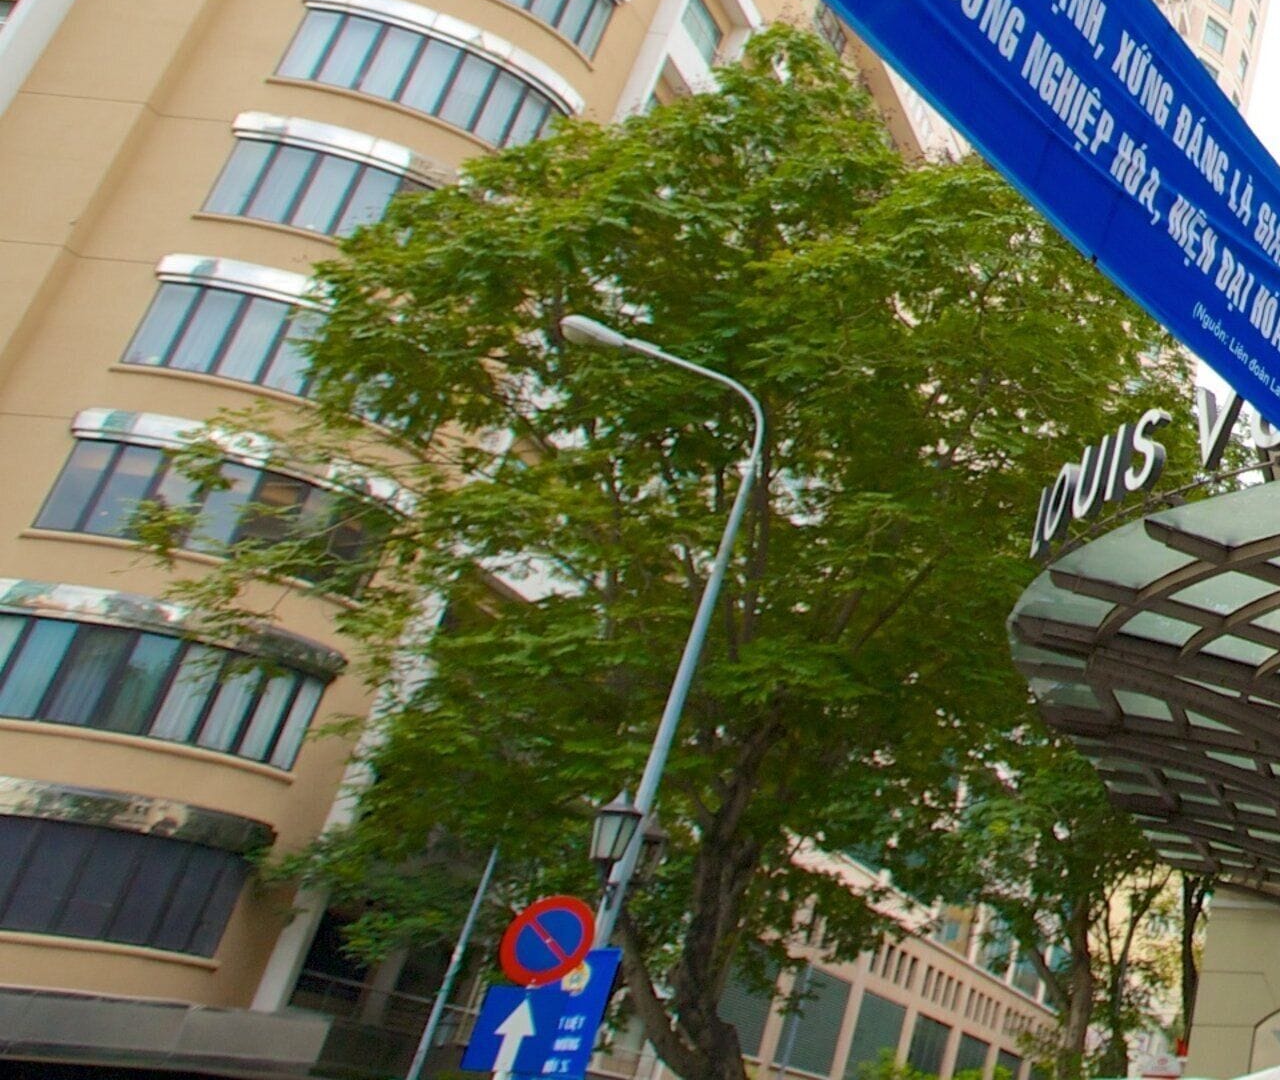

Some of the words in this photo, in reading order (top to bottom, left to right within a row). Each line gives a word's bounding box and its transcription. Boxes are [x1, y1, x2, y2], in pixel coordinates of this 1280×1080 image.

[1021, 31, 1114, 155] NGHIỆP
[1168, 193, 1218, 275] HIỆN
[1214, 246, 1255, 314] ĐẠI
[1111, 29, 1174, 130] XỨNG
[1172, 103, 1229, 196] ĐÁNG
[1229, 168, 1254, 227] LÀ
[1229, 337, 1249, 366] Liên
[1248, 358, 1270, 386] đoàn
[1028, 408, 1173, 560] LOUIS
